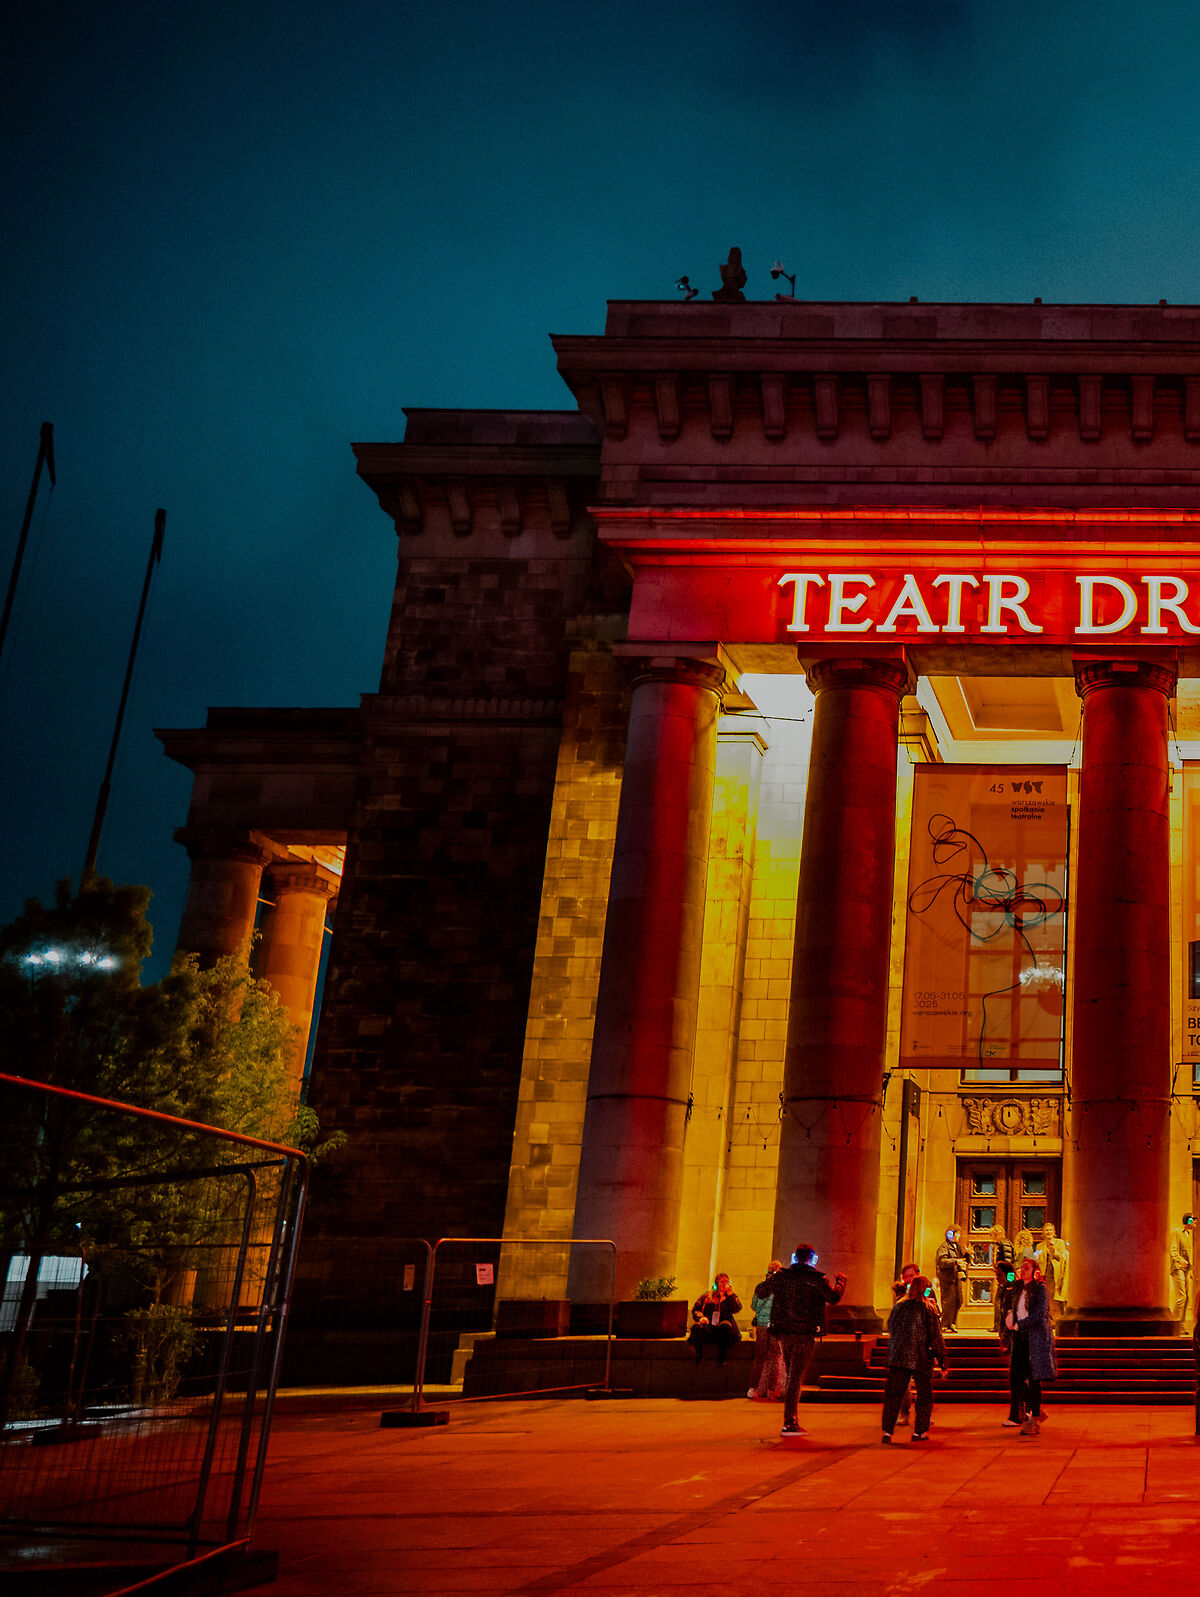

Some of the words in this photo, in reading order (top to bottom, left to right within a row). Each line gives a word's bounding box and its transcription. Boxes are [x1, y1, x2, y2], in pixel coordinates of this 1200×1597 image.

[777, 573, 1044, 633] TEATR
[989, 783, 1004, 794] 45
[1011, 806, 1045, 814] spotkania
[1011, 813, 1043, 821] teatralne
